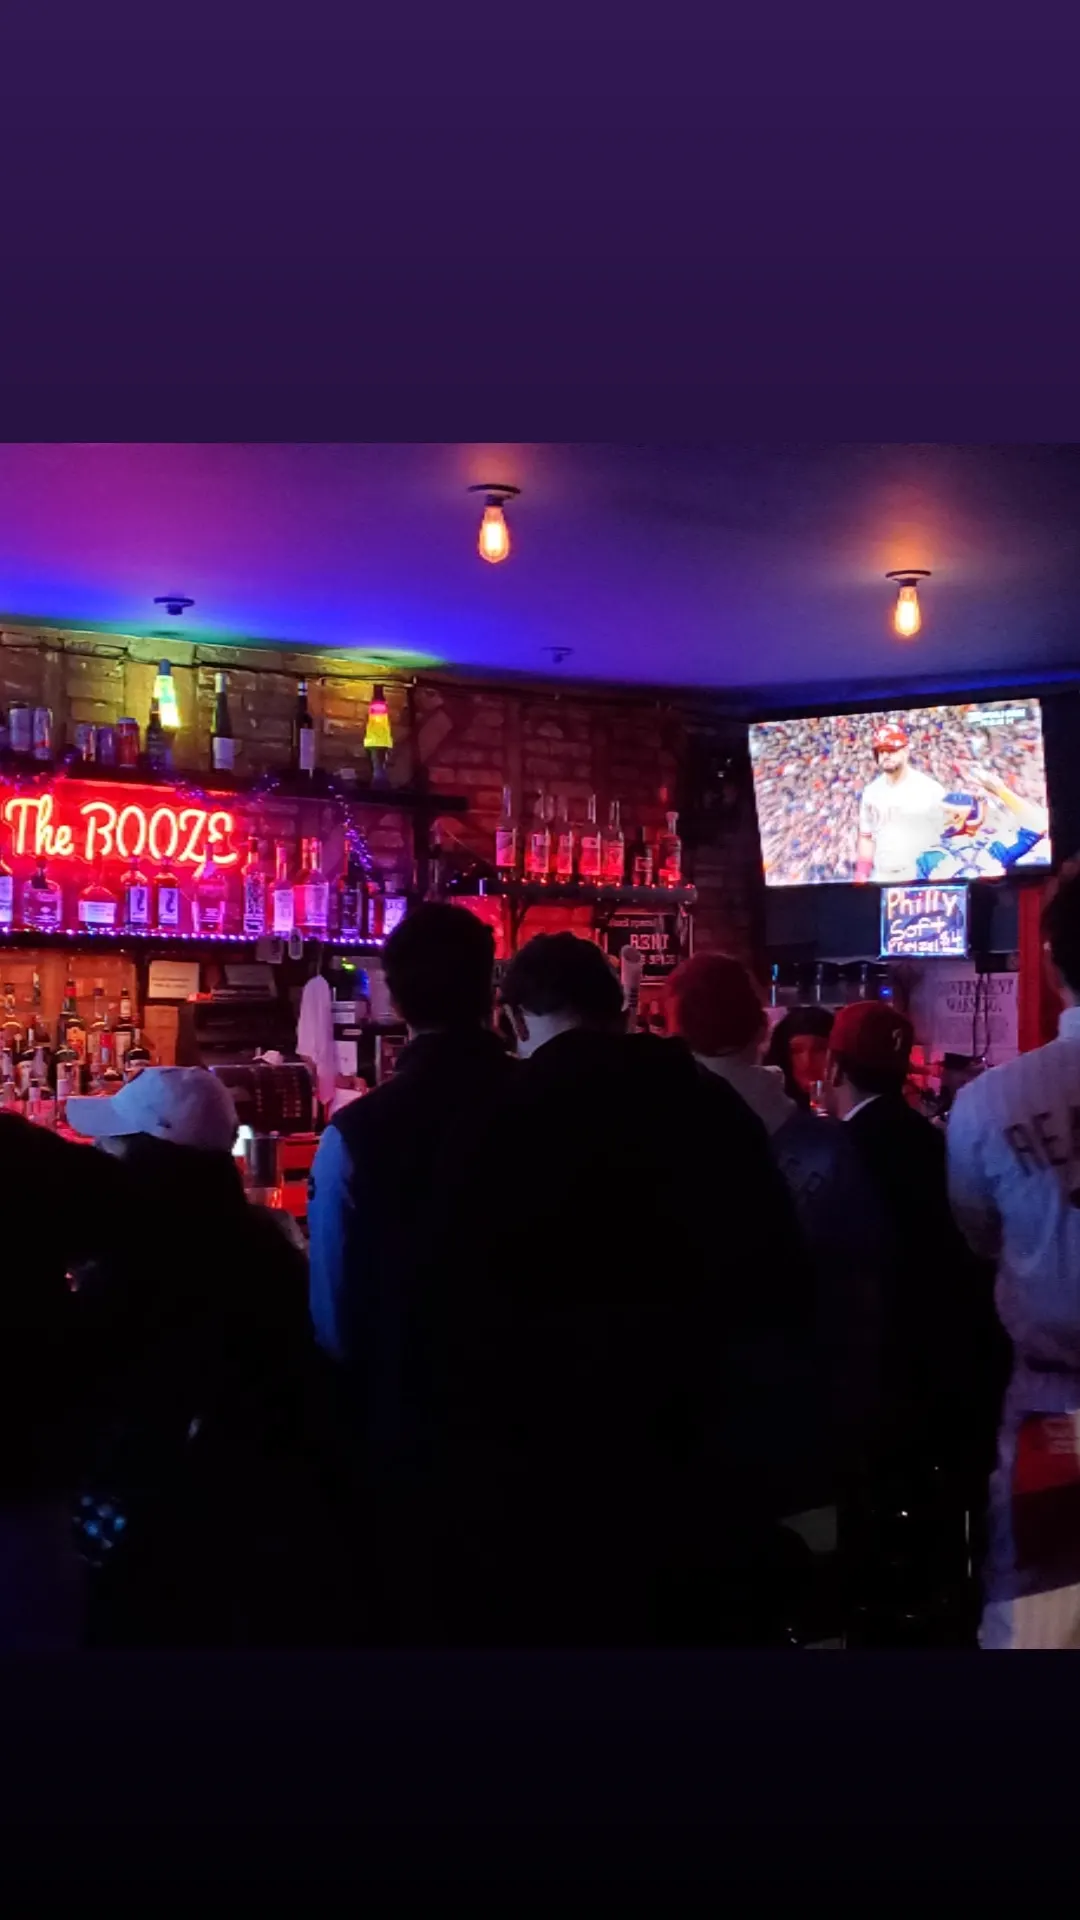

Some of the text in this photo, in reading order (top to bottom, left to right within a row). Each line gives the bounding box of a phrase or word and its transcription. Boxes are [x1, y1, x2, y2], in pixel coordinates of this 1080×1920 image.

[5, 794, 238, 863] The BOOZE
[887, 890, 958, 919] Philly
[890, 917, 946, 942] Soft
